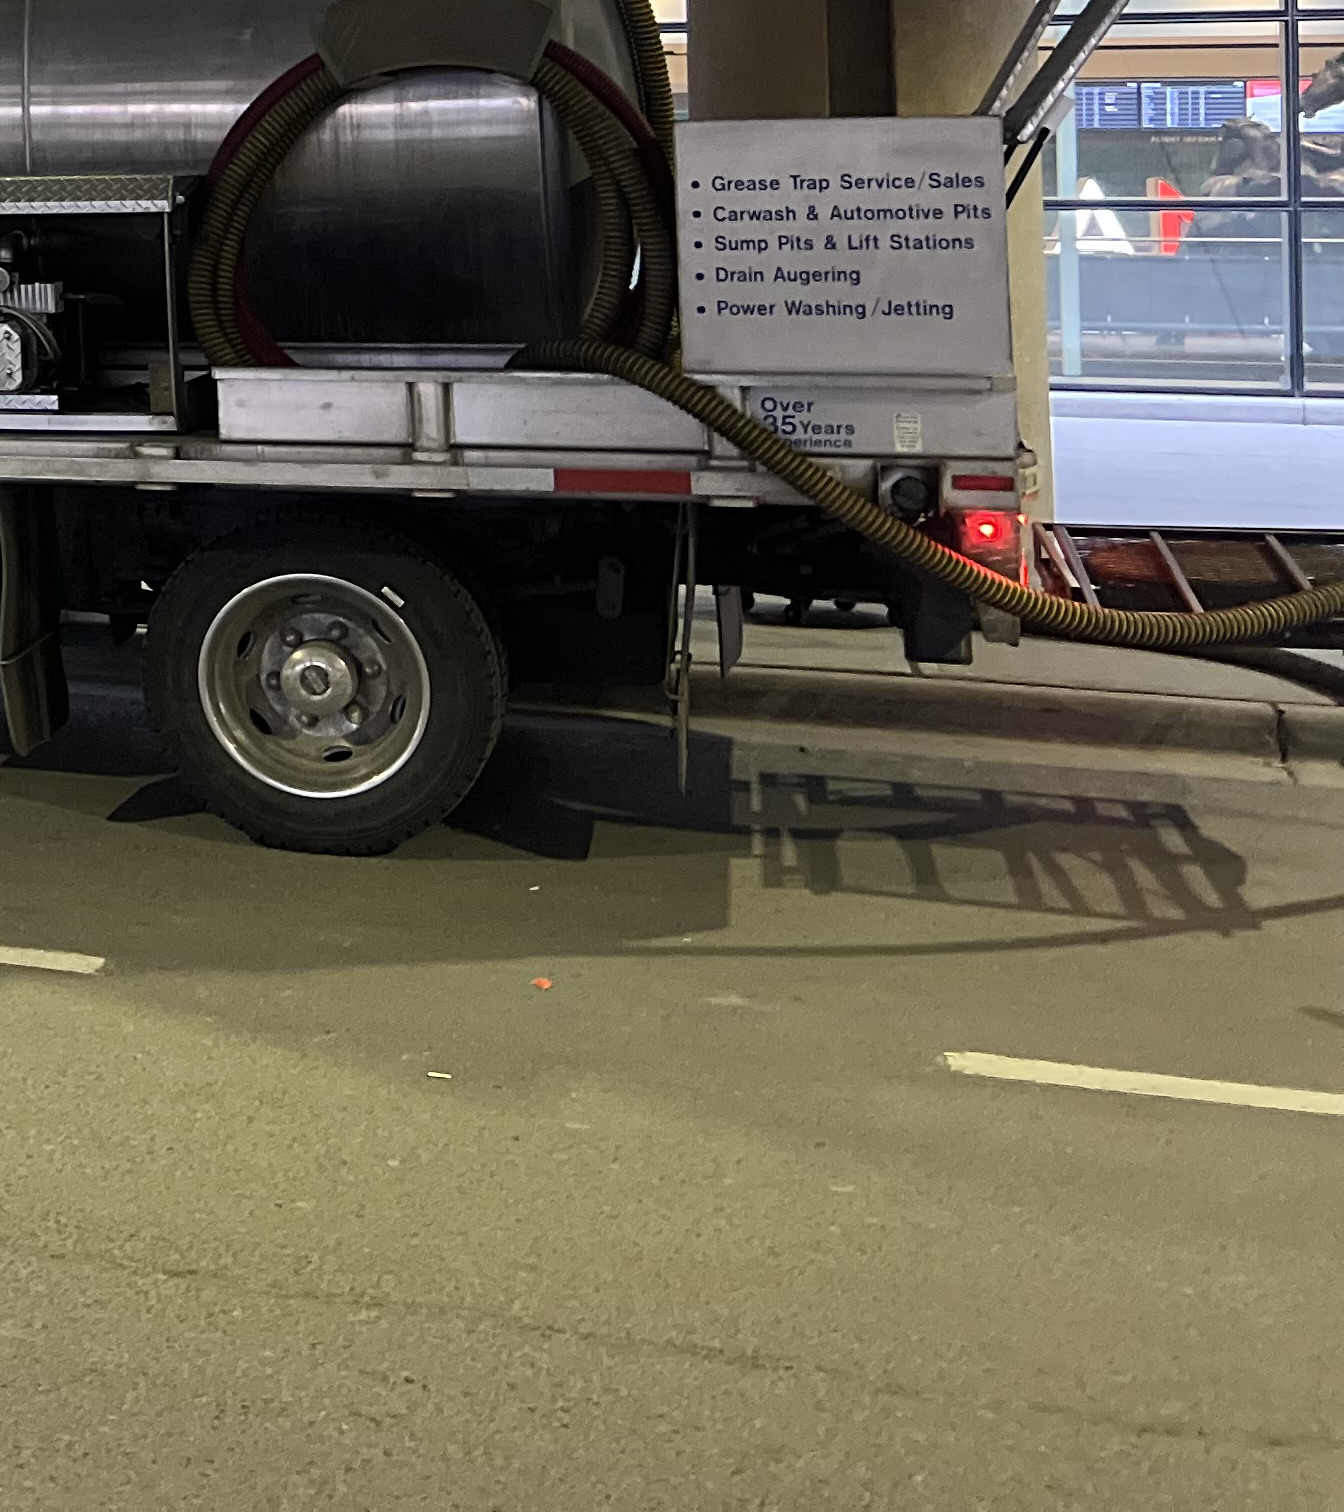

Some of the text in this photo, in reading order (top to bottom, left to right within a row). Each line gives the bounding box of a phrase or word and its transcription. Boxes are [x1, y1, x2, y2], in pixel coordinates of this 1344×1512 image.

[711, 175, 780, 191] Grease
[789, 174, 830, 193] Trap
[713, 203, 992, 222] Carwash & Automotive Pits
[714, 234, 975, 253] Sump Pits & Lift Stations
[715, 266, 861, 286] Drain Augering
[717, 300, 776, 317] Power
[760, 396, 815, 413] Over
[762, 414, 855, 435] 35 Years
